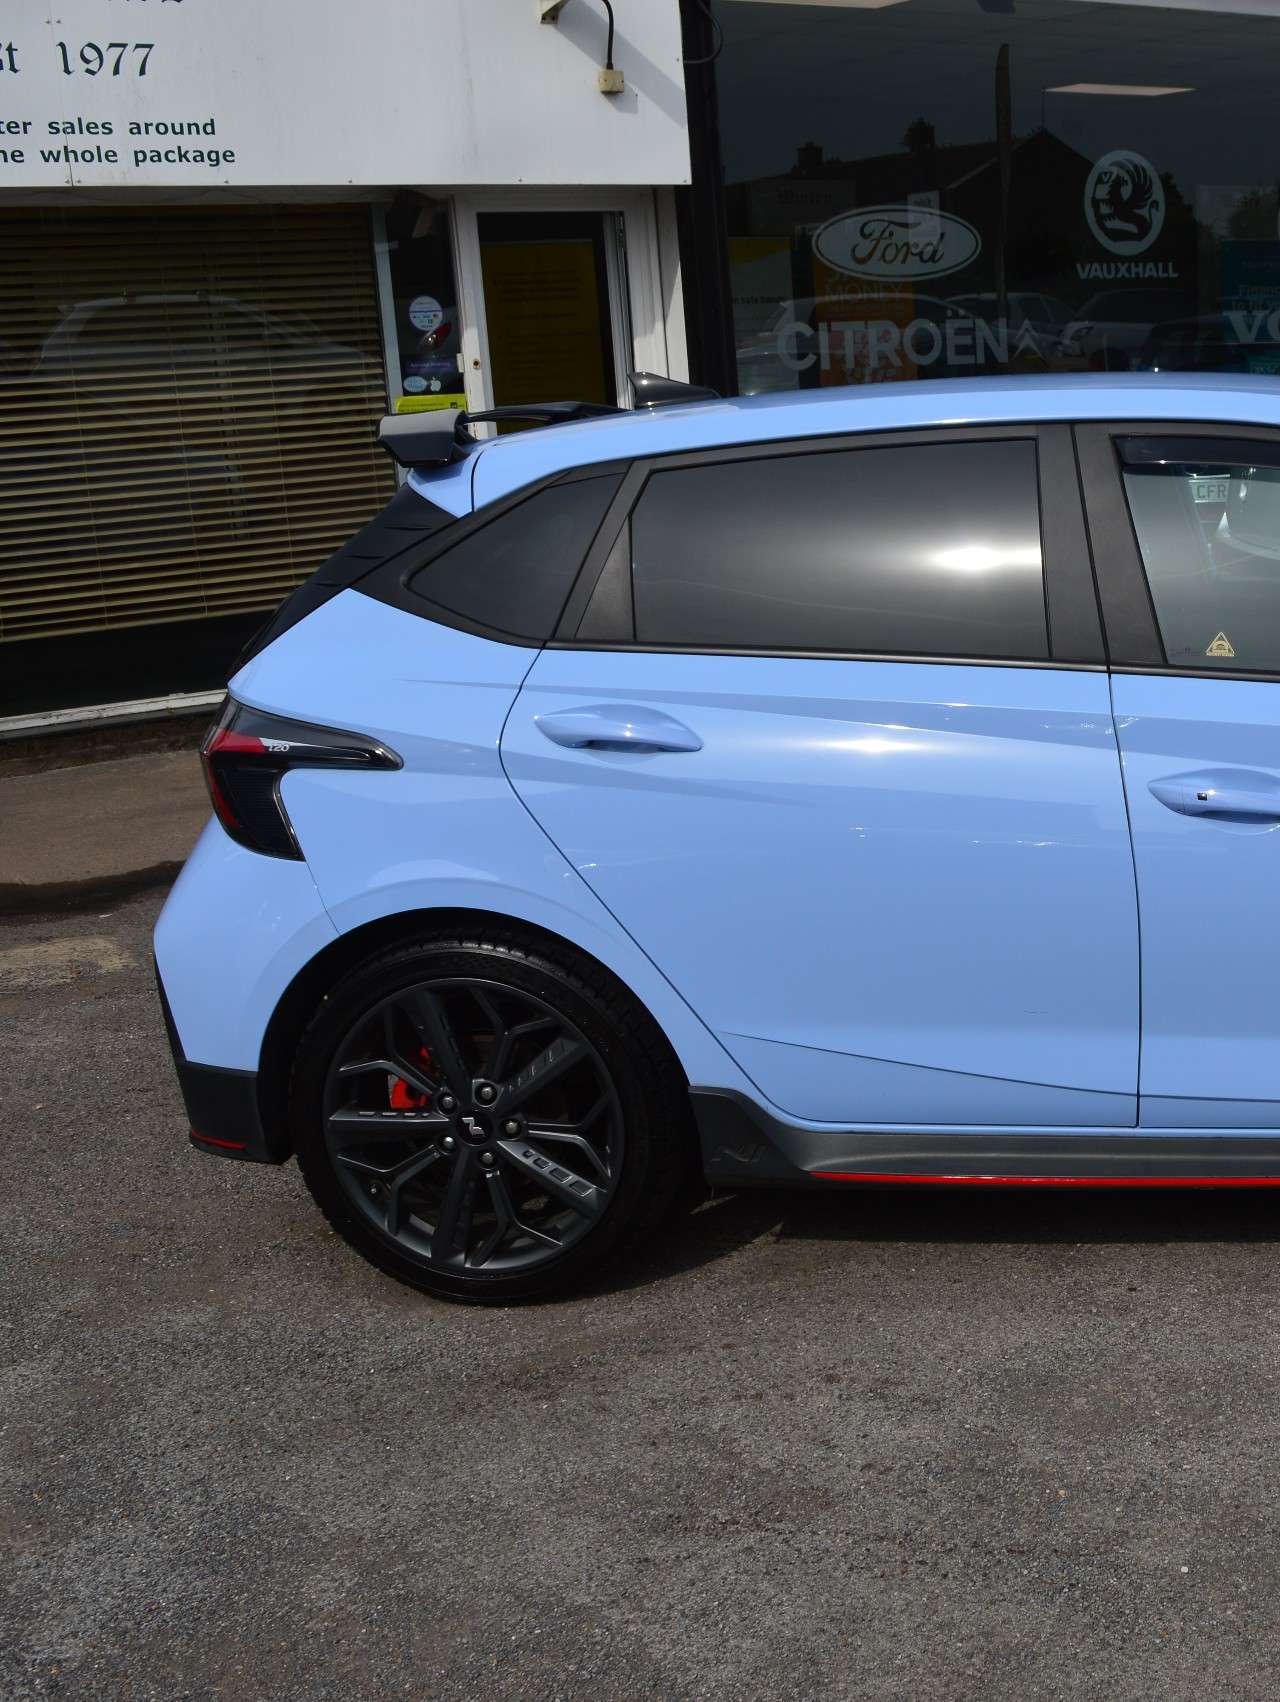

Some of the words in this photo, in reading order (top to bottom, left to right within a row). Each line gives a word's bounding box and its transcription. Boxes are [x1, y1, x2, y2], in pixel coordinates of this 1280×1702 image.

[56, 41, 155, 76] 1977
[48, 117, 113, 135] sales
[129, 119, 216, 136] around
[40, 146, 118, 163] whole
[134, 146, 236, 167] package
[852, 219, 945, 265] Ford
[1076, 262, 1179, 279] VAUXHALL
[777, 309, 1008, 370] CITROËN
